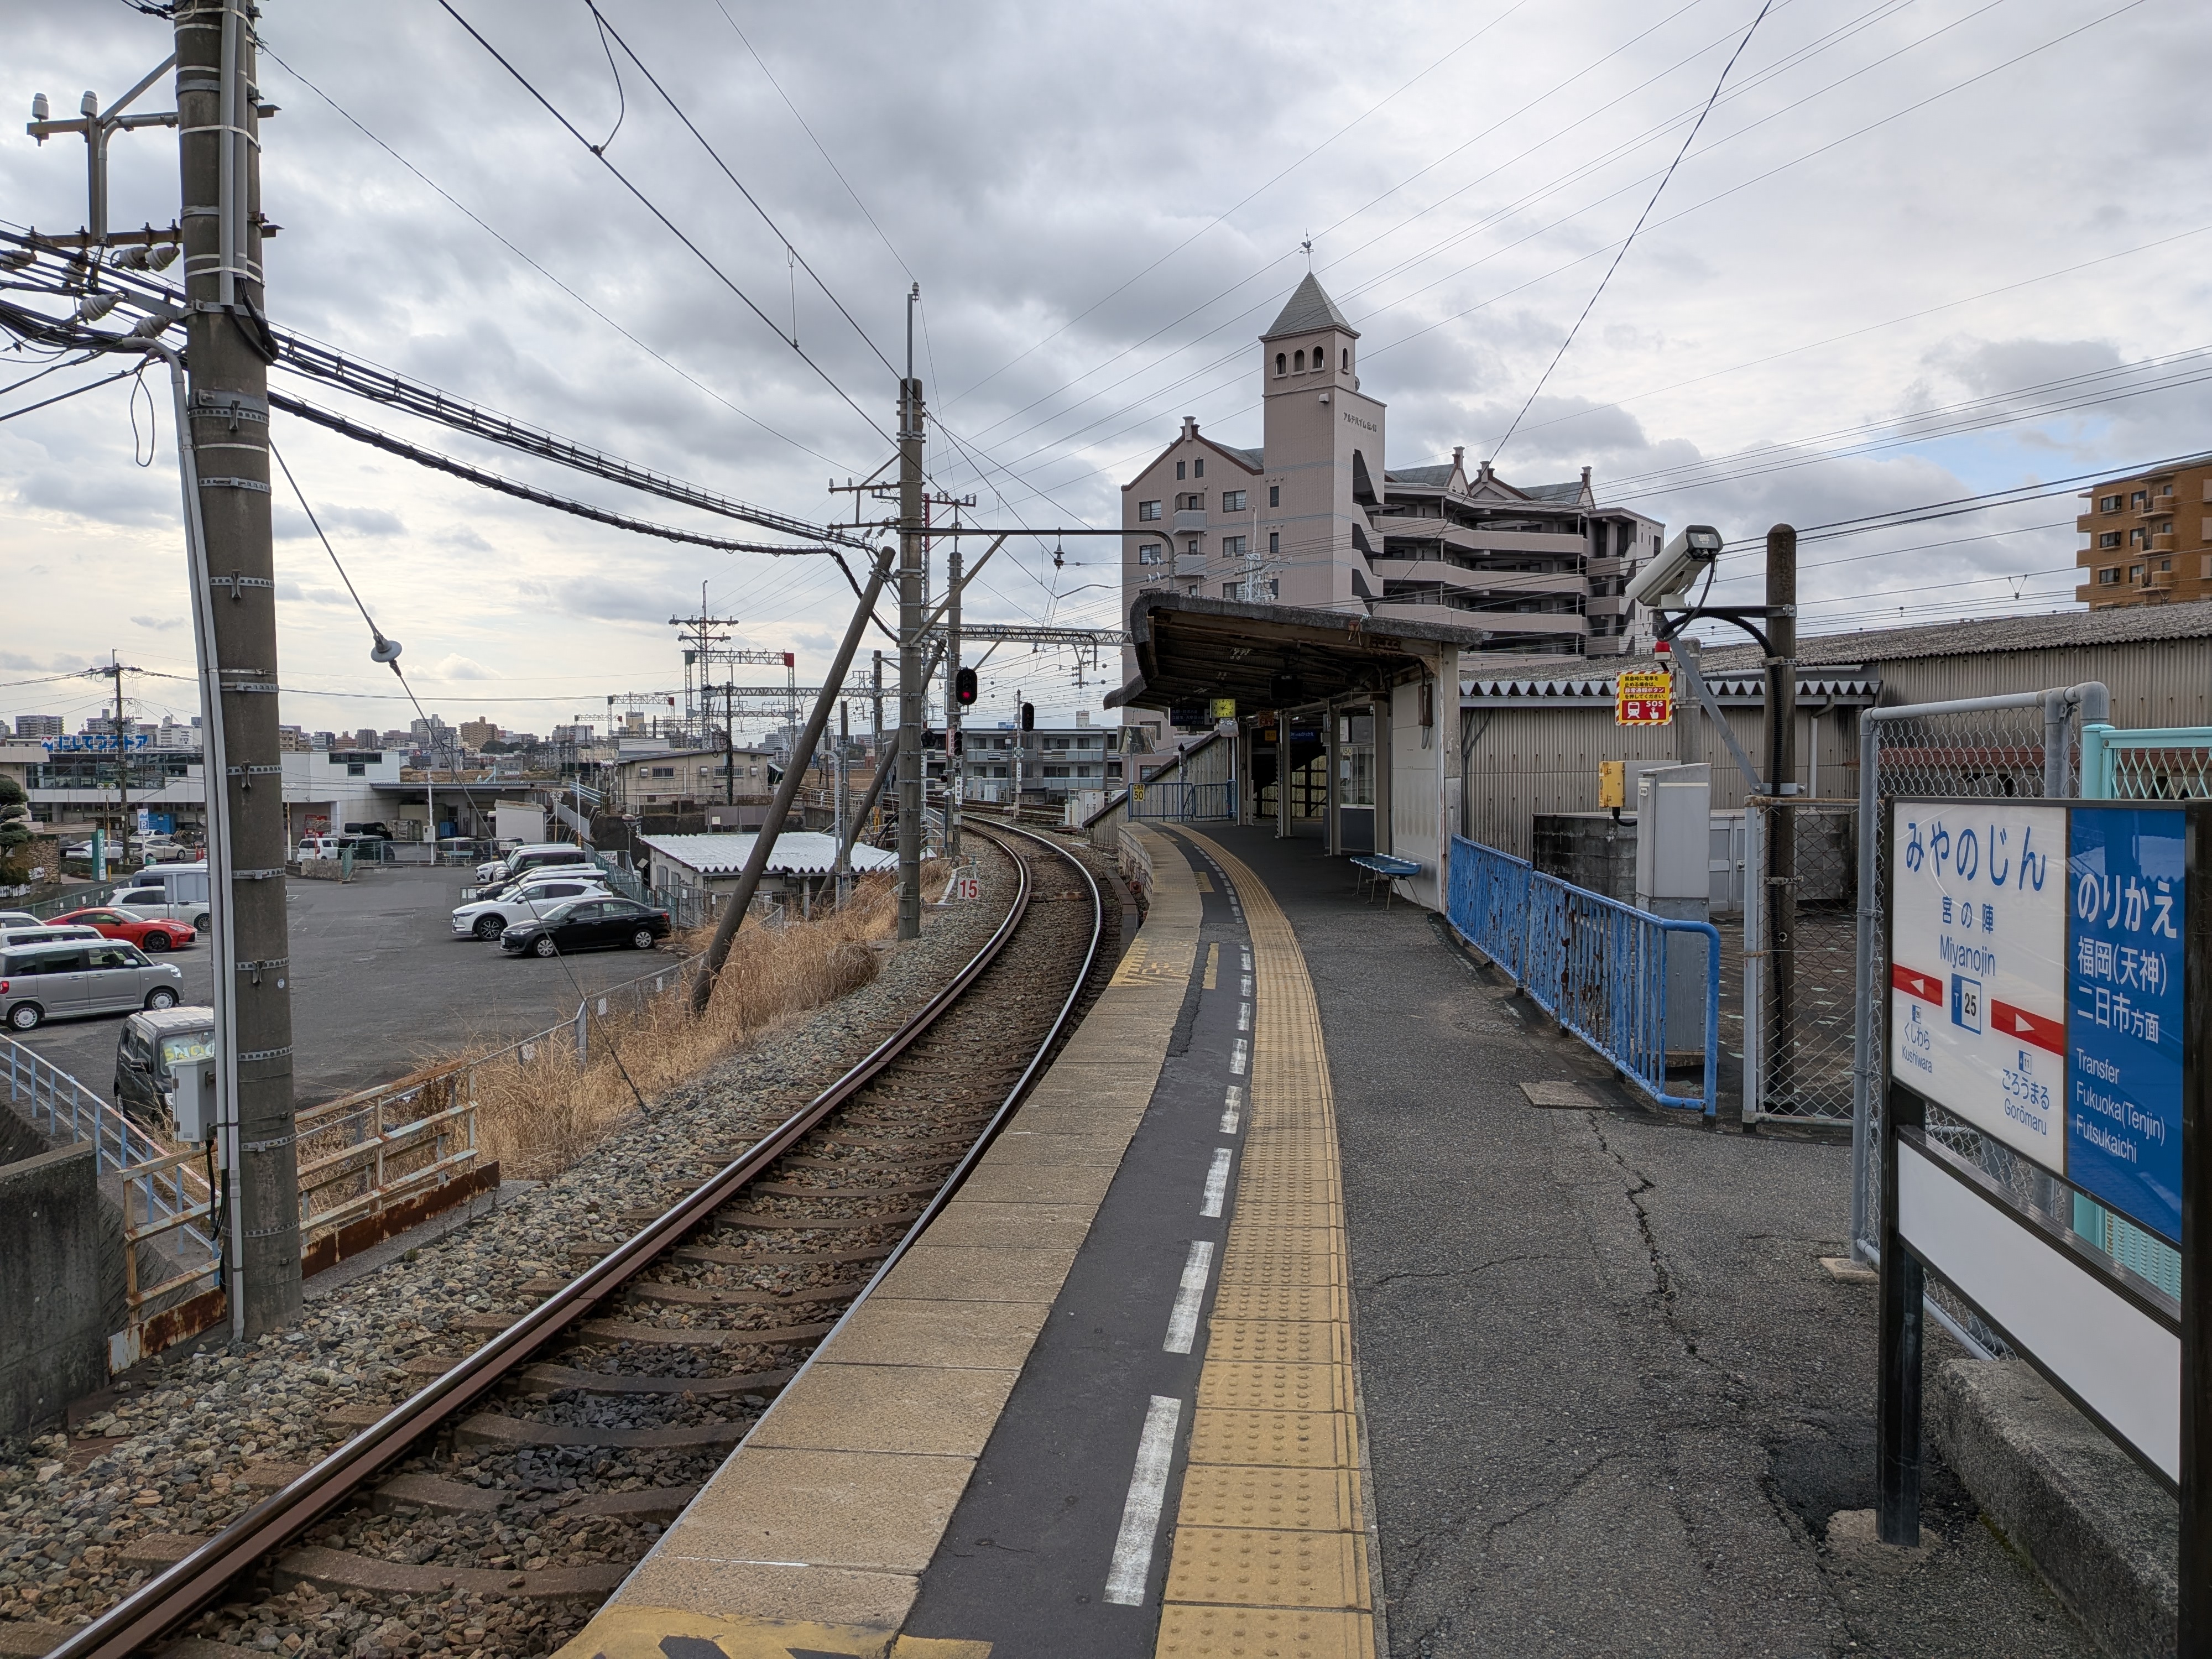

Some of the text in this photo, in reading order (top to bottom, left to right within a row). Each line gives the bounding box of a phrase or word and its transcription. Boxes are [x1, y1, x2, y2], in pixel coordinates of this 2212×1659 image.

[59, 735, 148, 751] にしてつストア
[1134, 791, 1144, 800] 50
[141, 821, 147, 829] P
[1906, 821, 2046, 891] みやのじん
[959, 879, 978, 898] 15
[2077, 874, 2177, 939] のりかえ
[1942, 895, 1994, 934] 宮の陣
[1939, 933, 1996, 978] Miyanojin
[2077, 935, 2167, 997] 福岡(天神)
[1954, 992, 1976, 1017] T 25
[2077, 985, 2159, 1044] 二日市方面
[1904, 1022, 1931, 1051] くしわら
[1901, 1044, 1932, 1074] Kushiwara
[2024, 1058, 2030, 1068] 11
[2076, 1047, 2120, 1084] Transfer
[2002, 1068, 2049, 1110] ごろうまる
[2004, 1098, 2047, 1136] Gorōmaru
[2076, 1080, 2166, 1147] Fukuoka(Tenjin)
[2076, 1113, 2137, 1164] Futsukaichi
